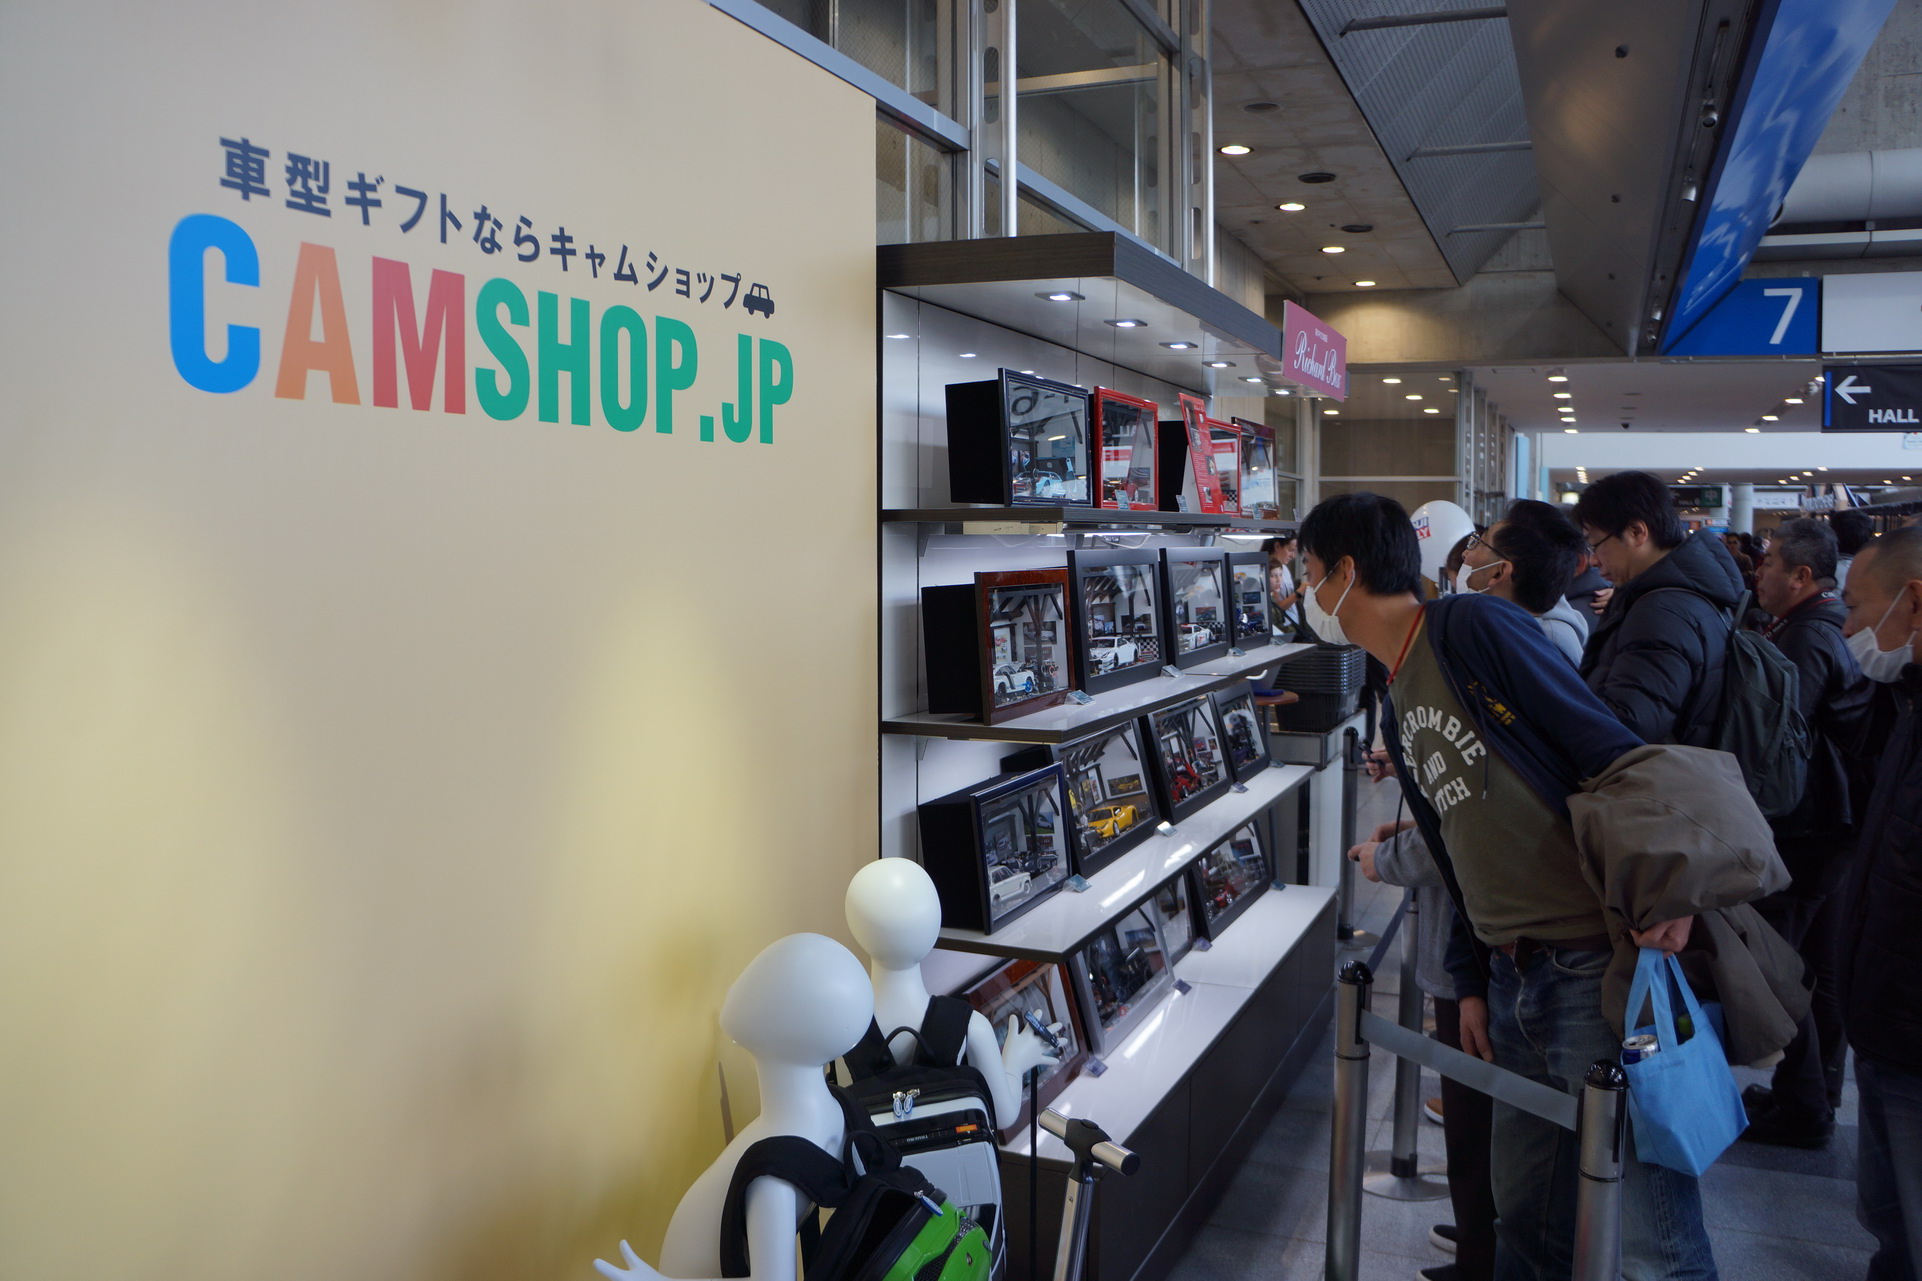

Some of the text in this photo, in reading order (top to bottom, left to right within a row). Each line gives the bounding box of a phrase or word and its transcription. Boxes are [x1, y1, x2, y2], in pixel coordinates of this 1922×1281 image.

[219, 137, 742, 310] 車型ギフトならキャムショップ
[168, 212, 794, 446] CAMSHOP.JP
[1763, 287, 1802, 344] 7
[1868, 408, 1920, 424] HALL
[1401, 705, 1487, 798] ERCROMBIE
[1422, 750, 1447, 785] AND
[1434, 776, 1472, 814] ITCH
